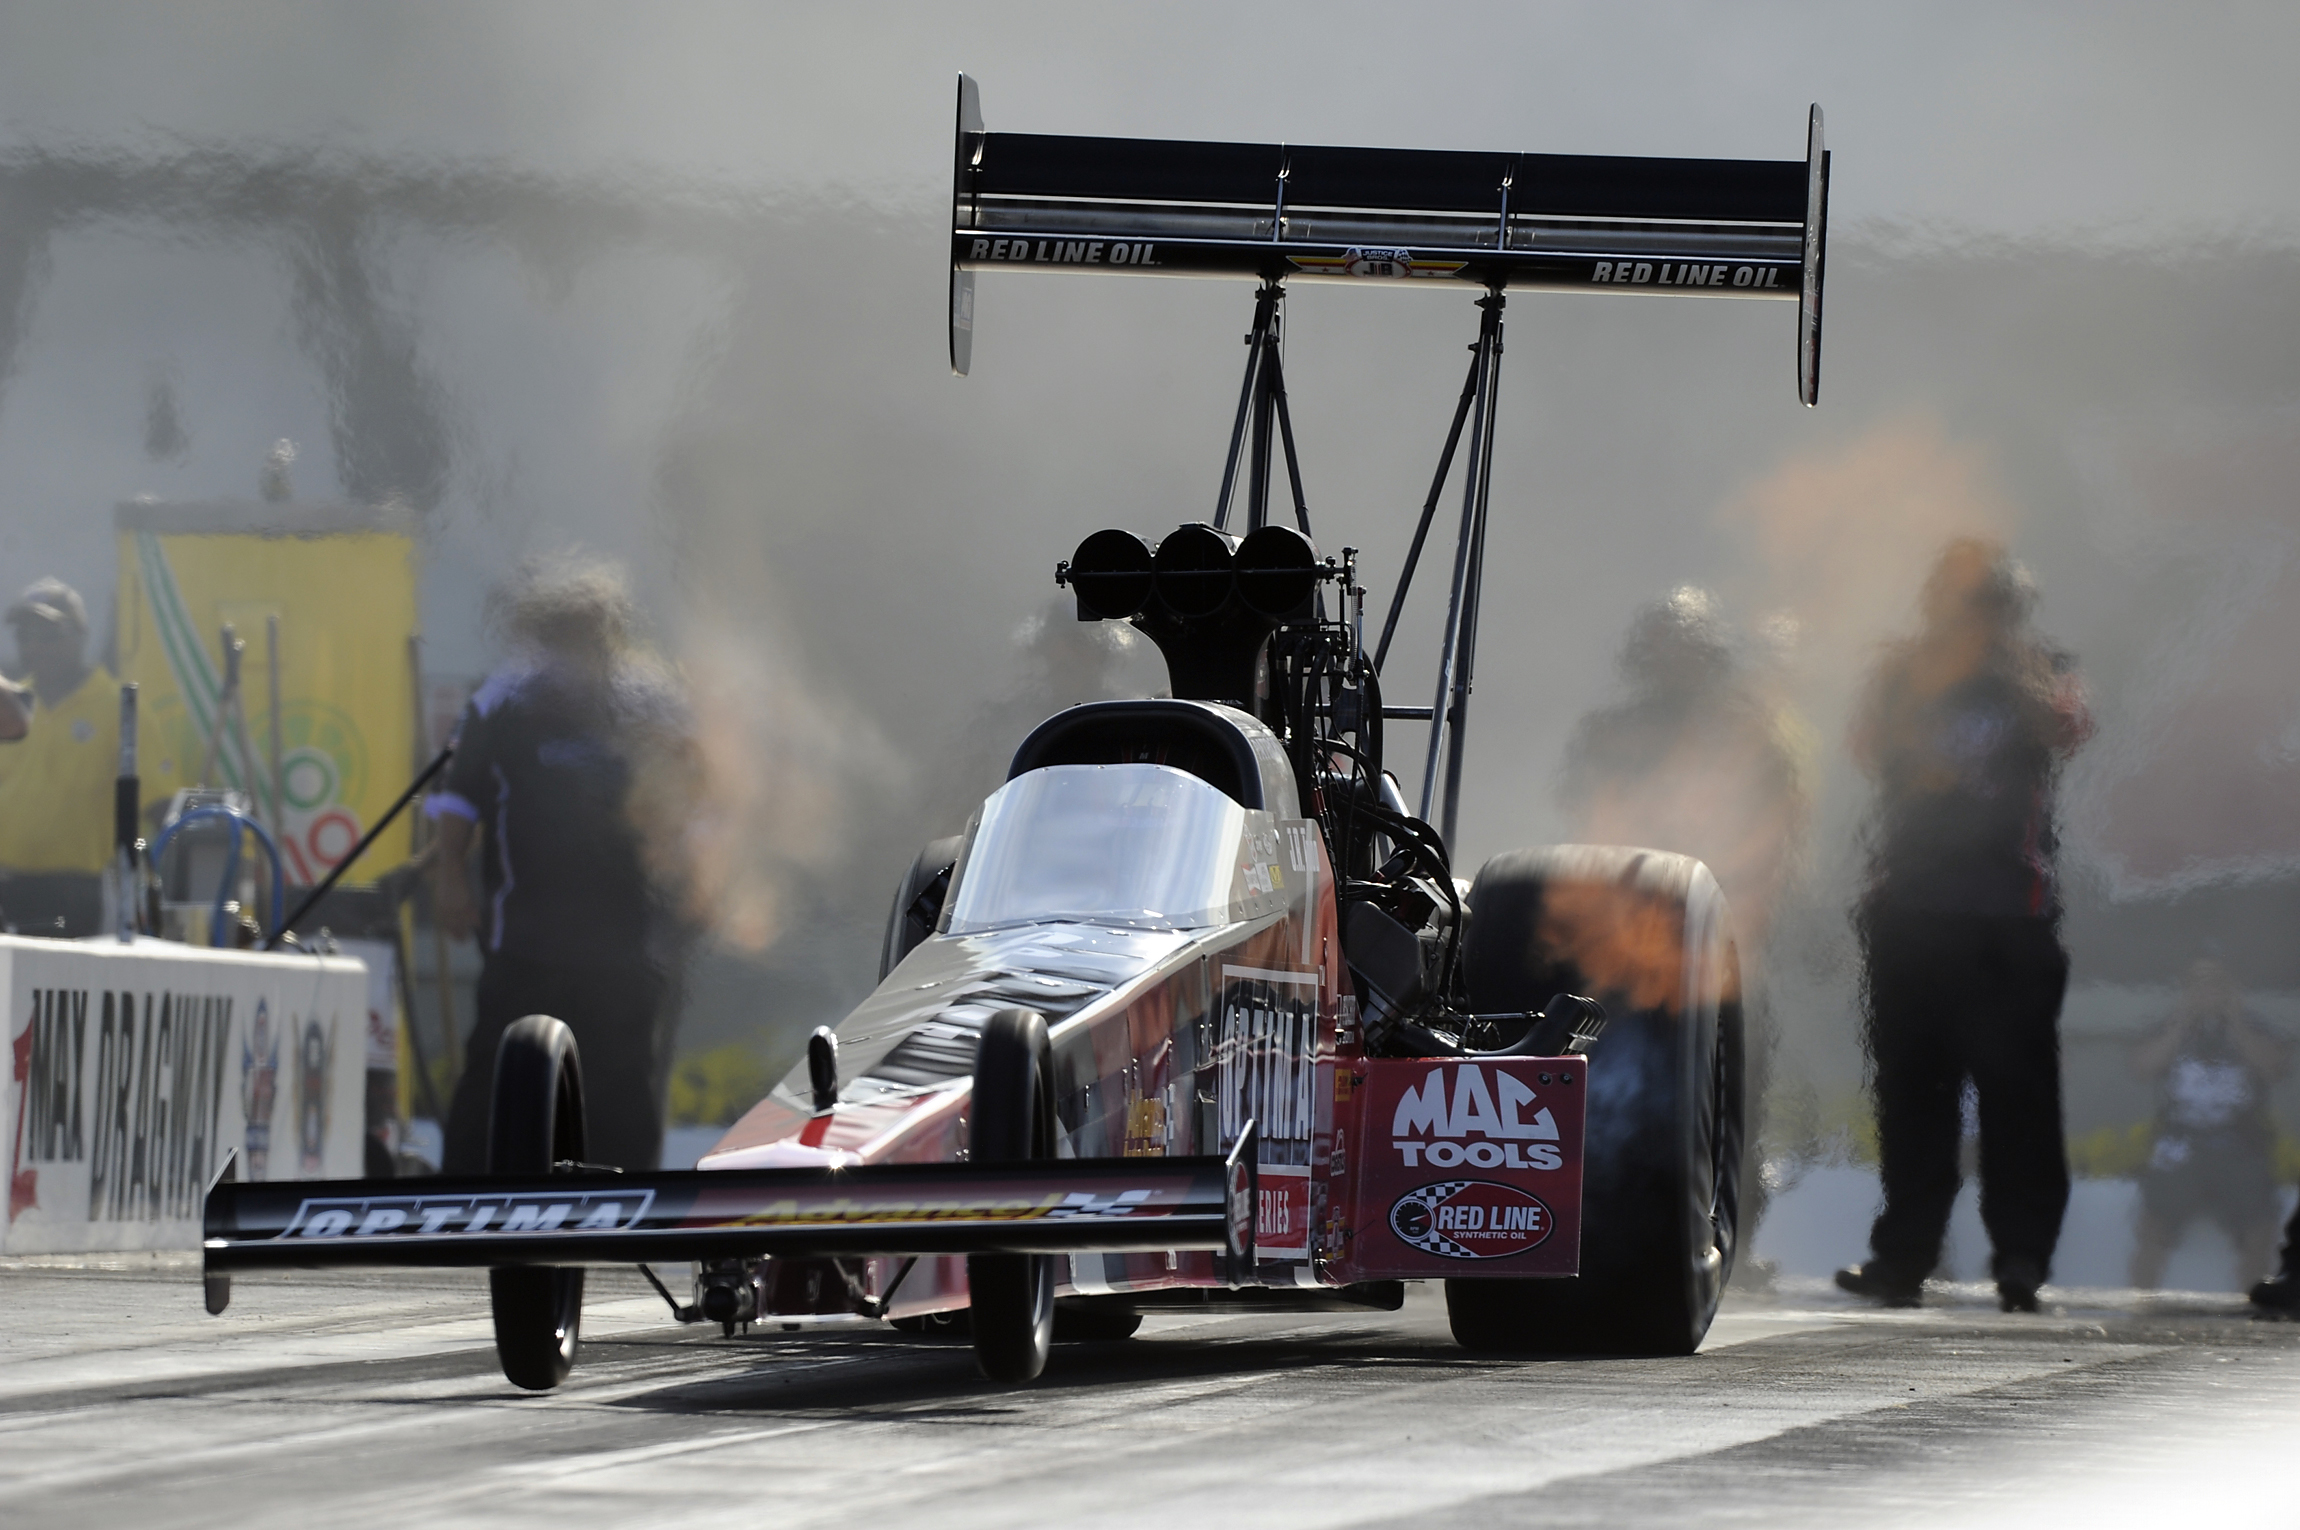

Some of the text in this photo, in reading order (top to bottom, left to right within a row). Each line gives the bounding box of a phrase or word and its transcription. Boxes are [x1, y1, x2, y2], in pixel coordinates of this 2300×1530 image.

[970, 239, 1156, 265] RED LINE OIL
[1592, 261, 1779, 288] RED LINE OIL
[1223, 1003, 1309, 1140] OPTIMA
[1392, 1064, 1560, 1140] MAC
[1392, 1141, 1563, 1170] TOOLS
[299, 1201, 625, 1237] OPTIMA
[1259, 1189, 1289, 1235] ERIES
[1438, 1206, 1541, 1231] RED LINE
[1453, 1231, 1527, 1240] SYNTHETIC OIL
